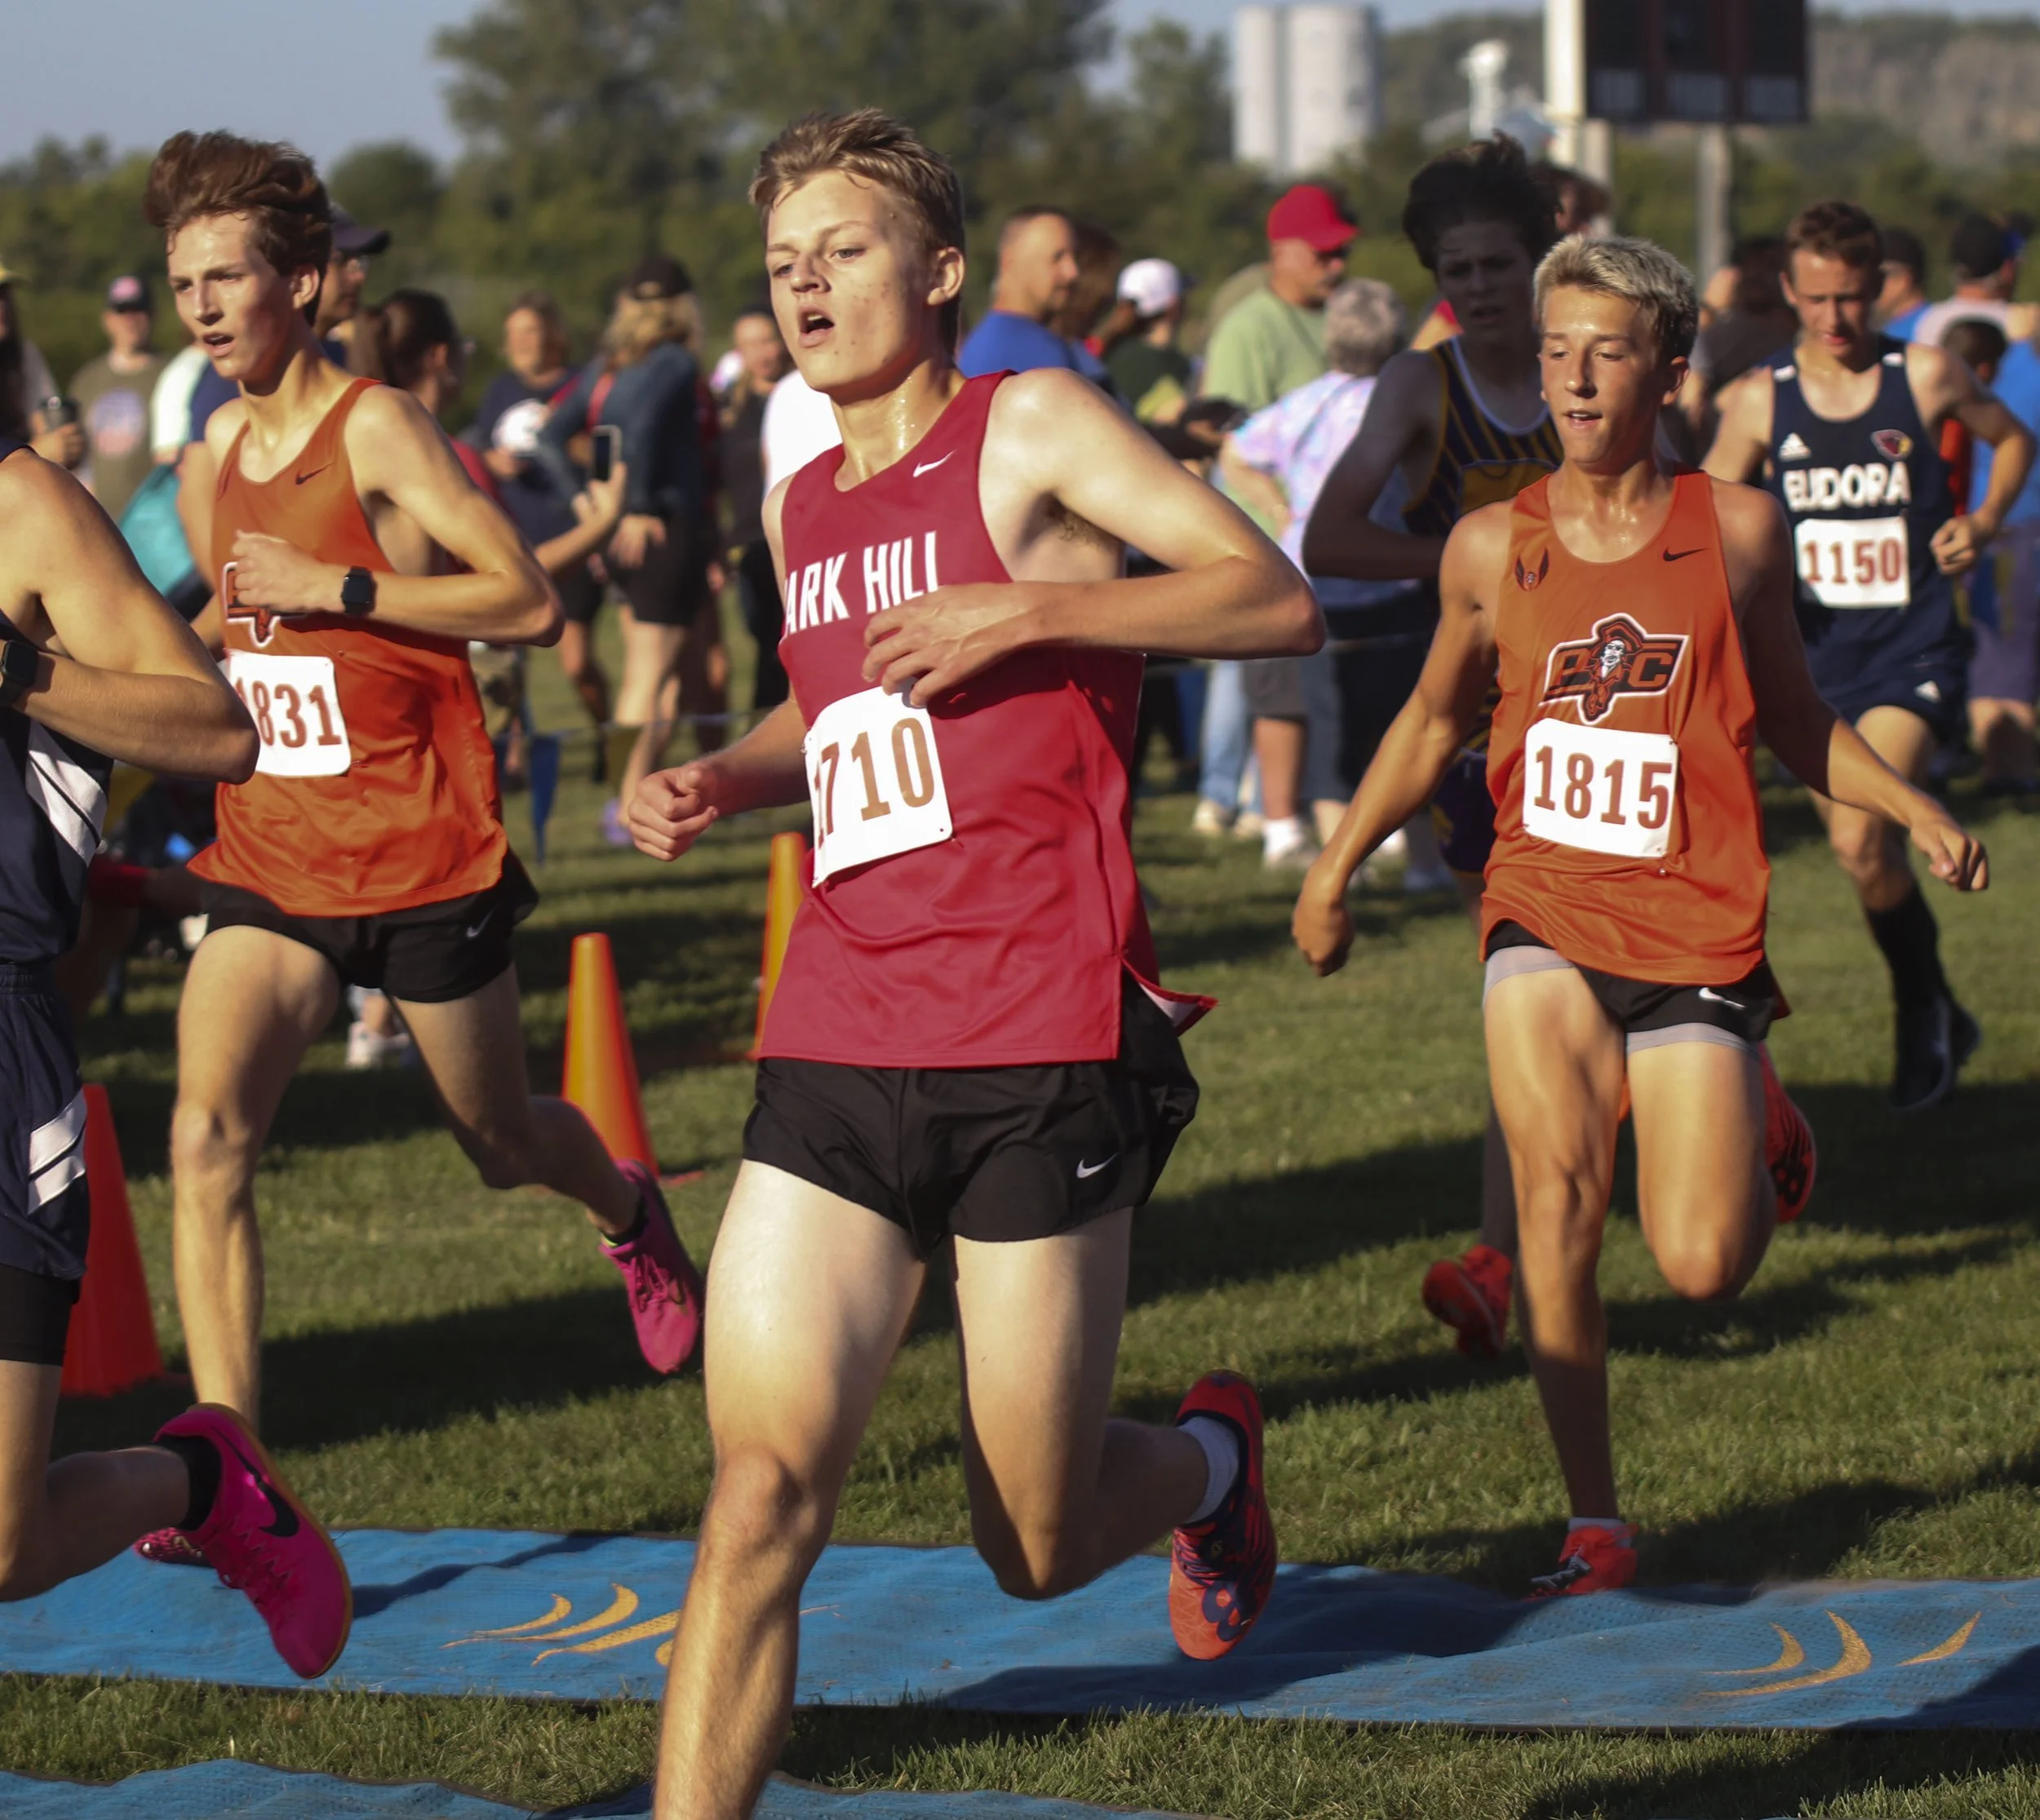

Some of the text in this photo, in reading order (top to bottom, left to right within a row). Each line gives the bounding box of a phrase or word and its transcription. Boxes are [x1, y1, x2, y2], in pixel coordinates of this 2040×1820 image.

[1782, 460, 1911, 512] EUDORA
[784, 551, 850, 635] ARK
[1802, 537, 1902, 585] 1150
[1534, 744, 1673, 830] 1815
